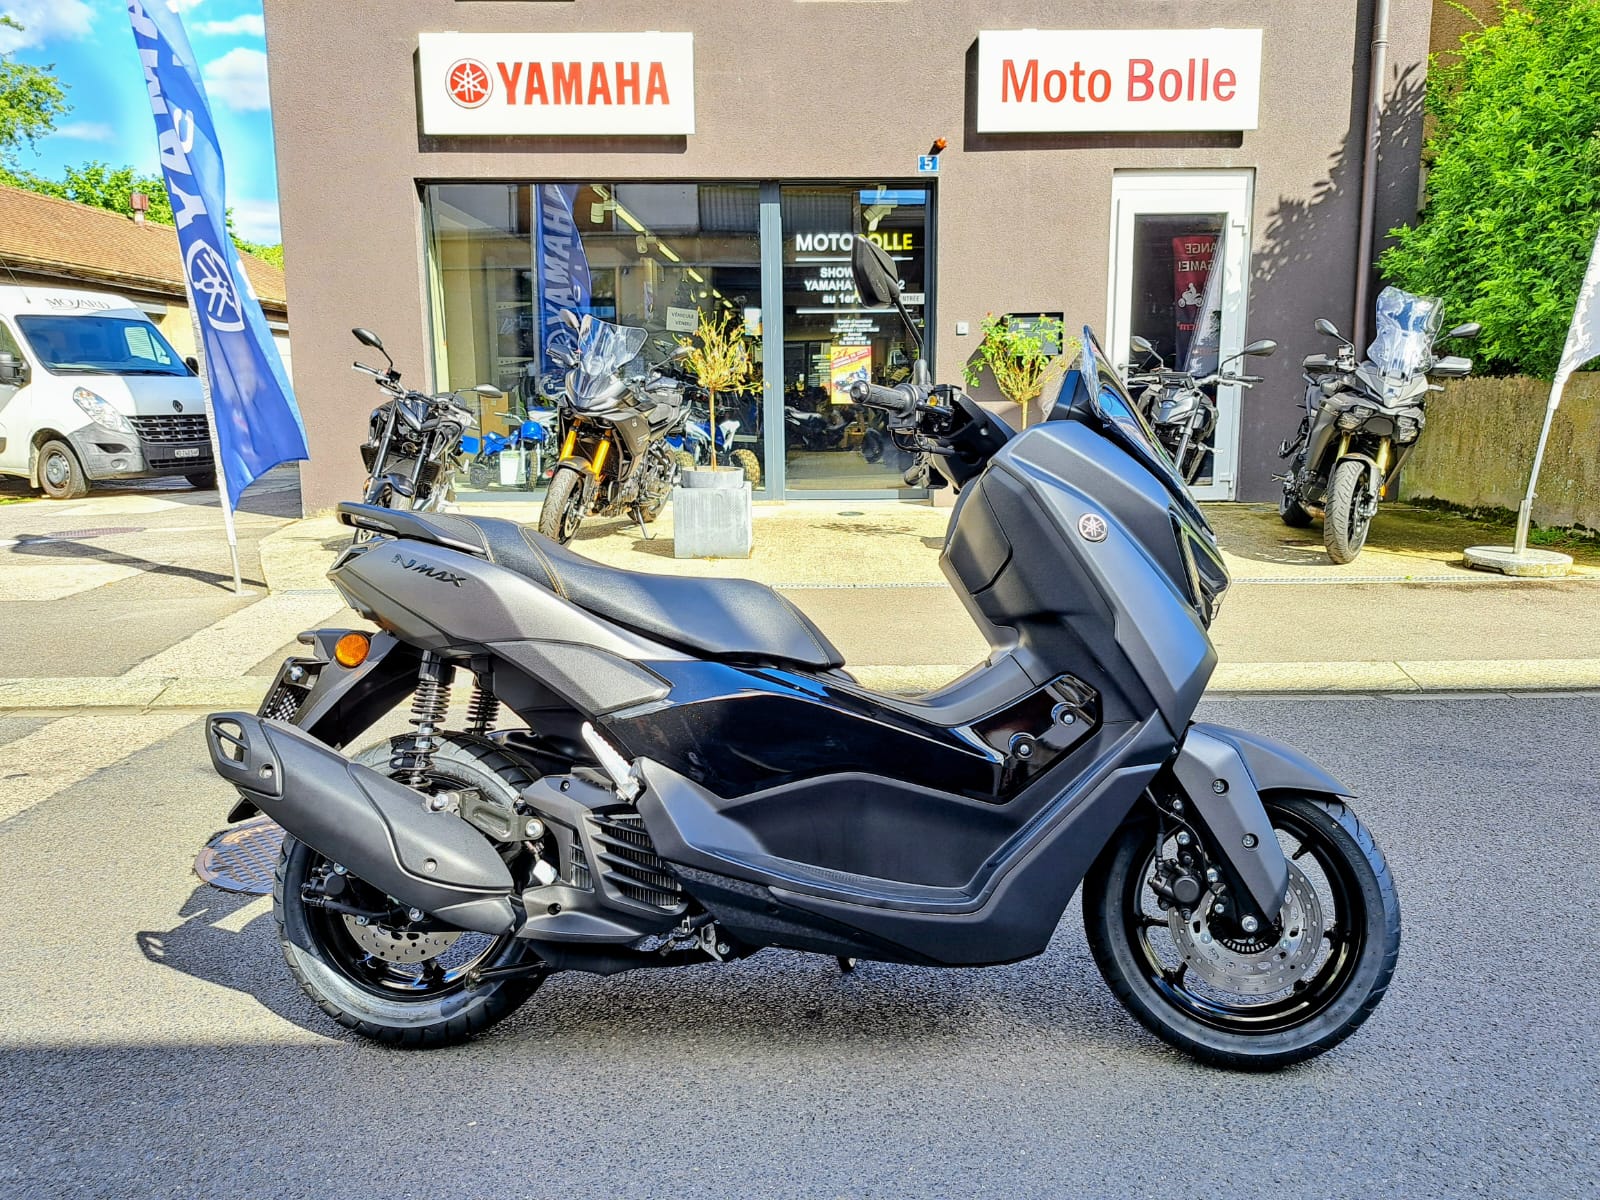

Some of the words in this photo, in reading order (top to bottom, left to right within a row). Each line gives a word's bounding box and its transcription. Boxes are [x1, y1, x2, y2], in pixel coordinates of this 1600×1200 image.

[496, 62, 670, 105] YAMAHA
[1001, 59, 1111, 103] Moto
[1127, 58, 1237, 102] Bolle
[924, 156, 932, 169] 5
[859, 233, 913, 250] OLLE
[804, 280, 853, 291] YAMAHA
[390, 553, 467, 588] NMAX
